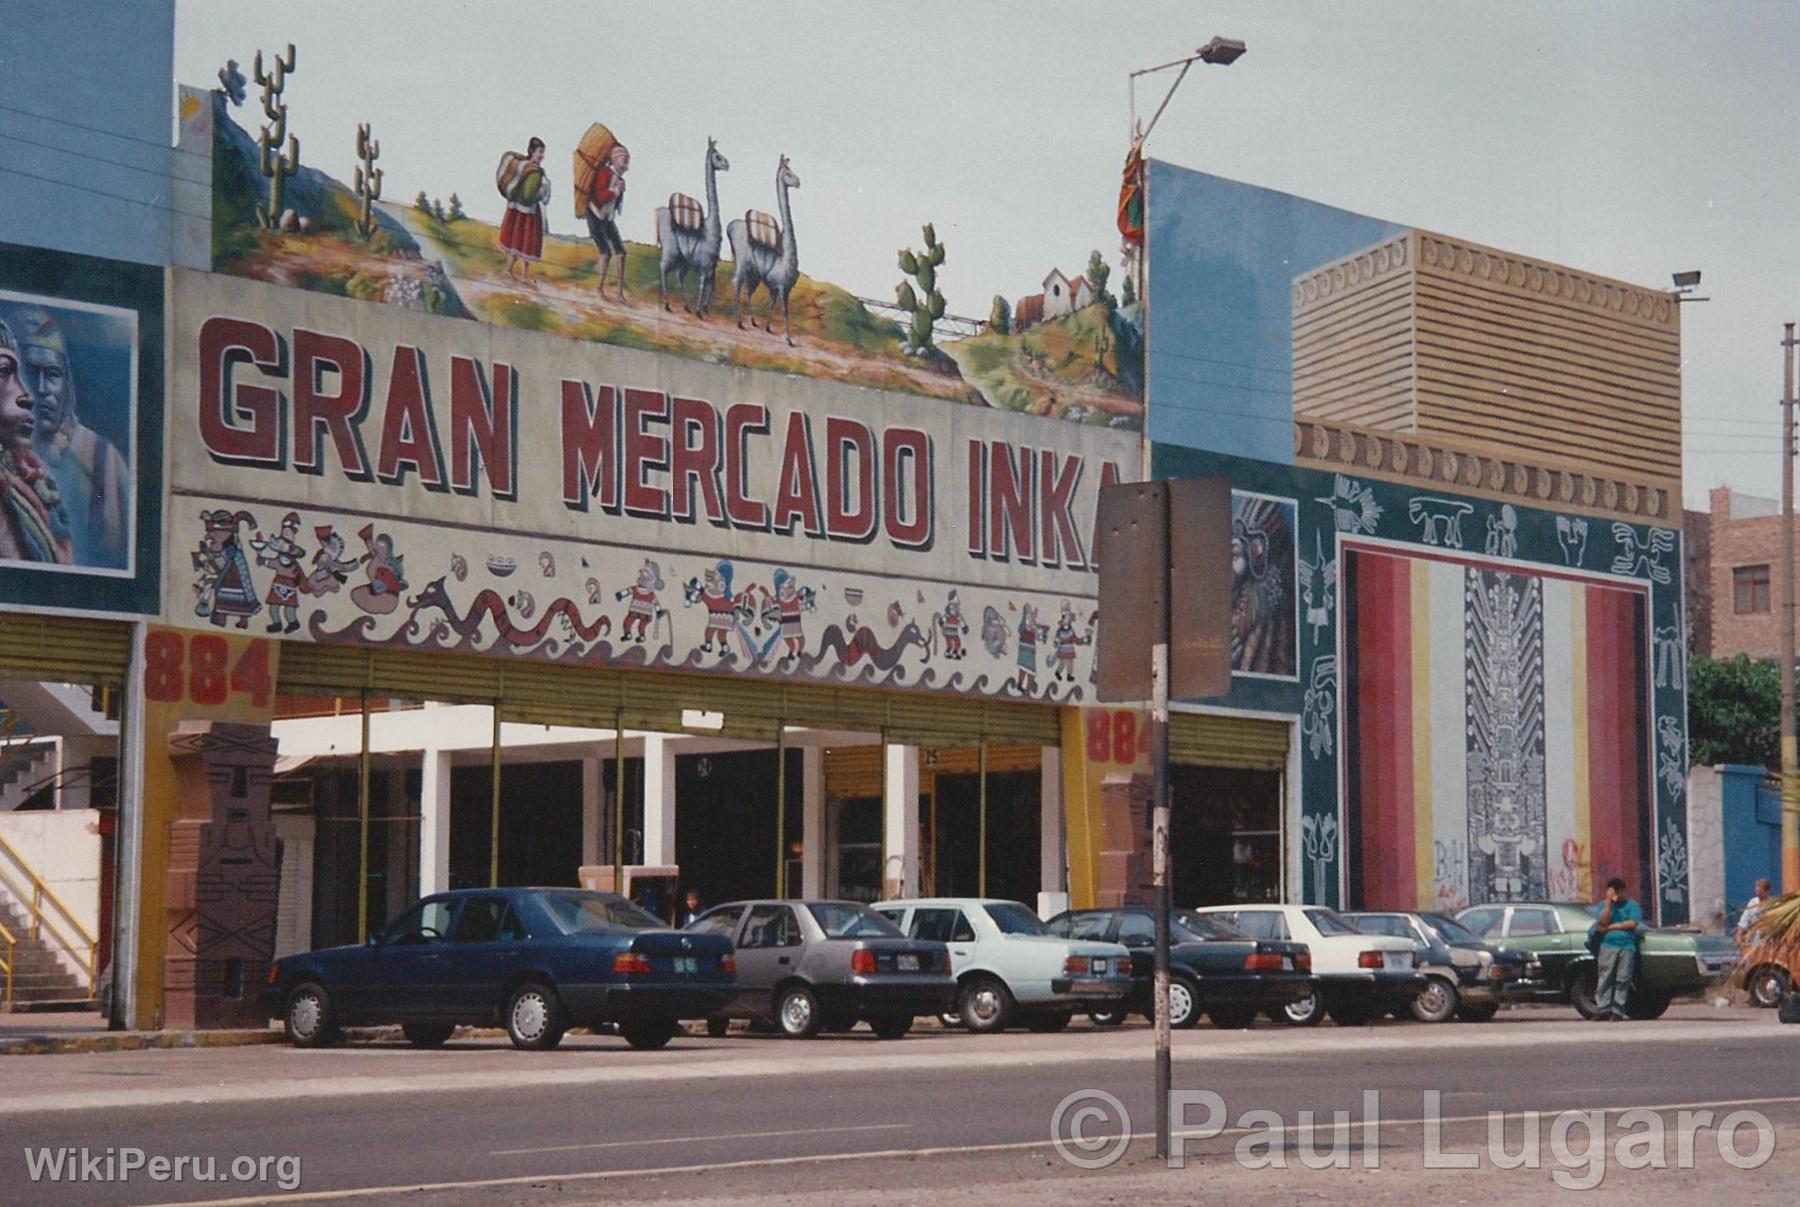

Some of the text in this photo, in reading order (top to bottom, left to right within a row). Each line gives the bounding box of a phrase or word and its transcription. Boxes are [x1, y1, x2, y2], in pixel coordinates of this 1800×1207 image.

[199, 315, 519, 503] GRAN
[561, 378, 935, 553] MERCADO
[144, 630, 273, 709] 884
